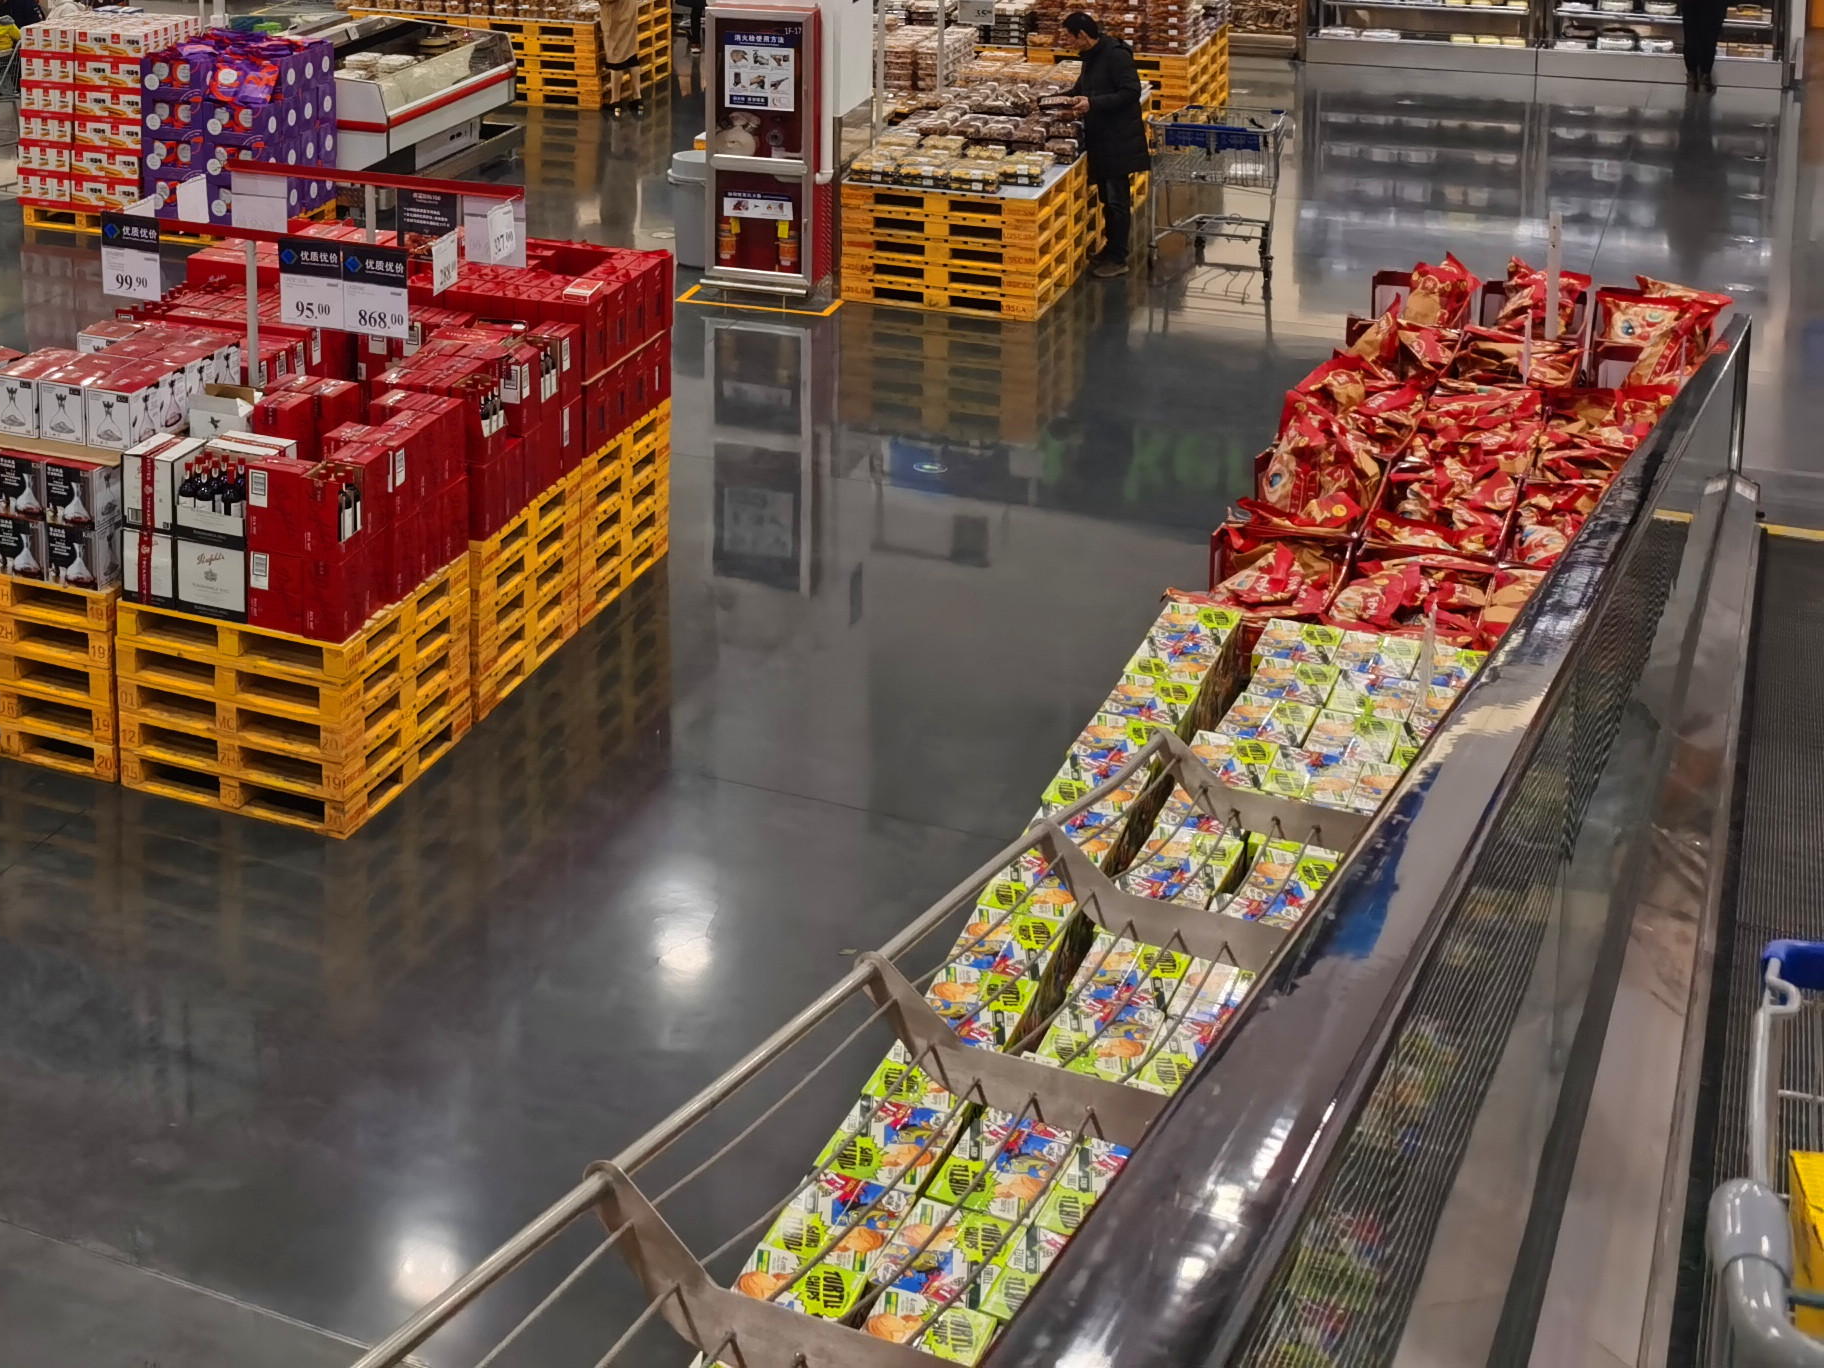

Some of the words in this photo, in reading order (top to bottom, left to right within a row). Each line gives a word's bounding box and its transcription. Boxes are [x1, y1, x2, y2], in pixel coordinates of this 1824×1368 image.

[122, 225, 158, 239] 优质优价
[300, 250, 339, 265] 优质优价
[364, 257, 405, 274] 优质优价
[115, 273, 149, 292] 99.90
[295, 300, 331, 320] 95.00
[357, 308, 405, 331] 868.00
[90, 643, 106, 660] 19
[94, 715, 110, 732] 19
[324, 773, 341, 791] 19
[804, 1275, 821, 1301] CHIPS
[821, 1270, 845, 1311] TURTLE
